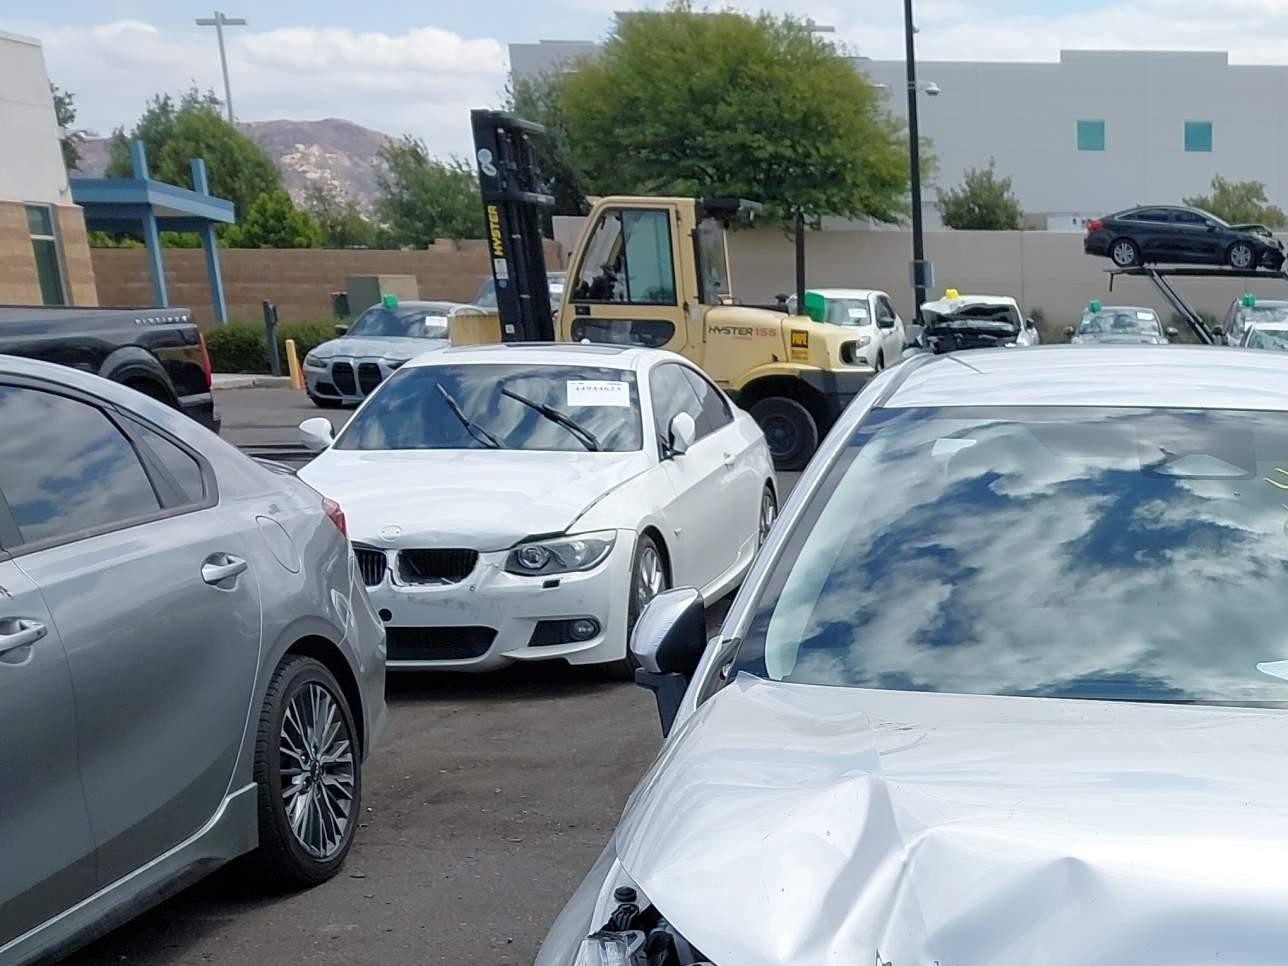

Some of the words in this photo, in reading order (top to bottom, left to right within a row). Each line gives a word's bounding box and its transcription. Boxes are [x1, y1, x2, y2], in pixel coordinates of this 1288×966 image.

[487, 205, 504, 256] HYSTER
[707, 326, 753, 337] HYSTER
[755, 327, 777, 337] 155
